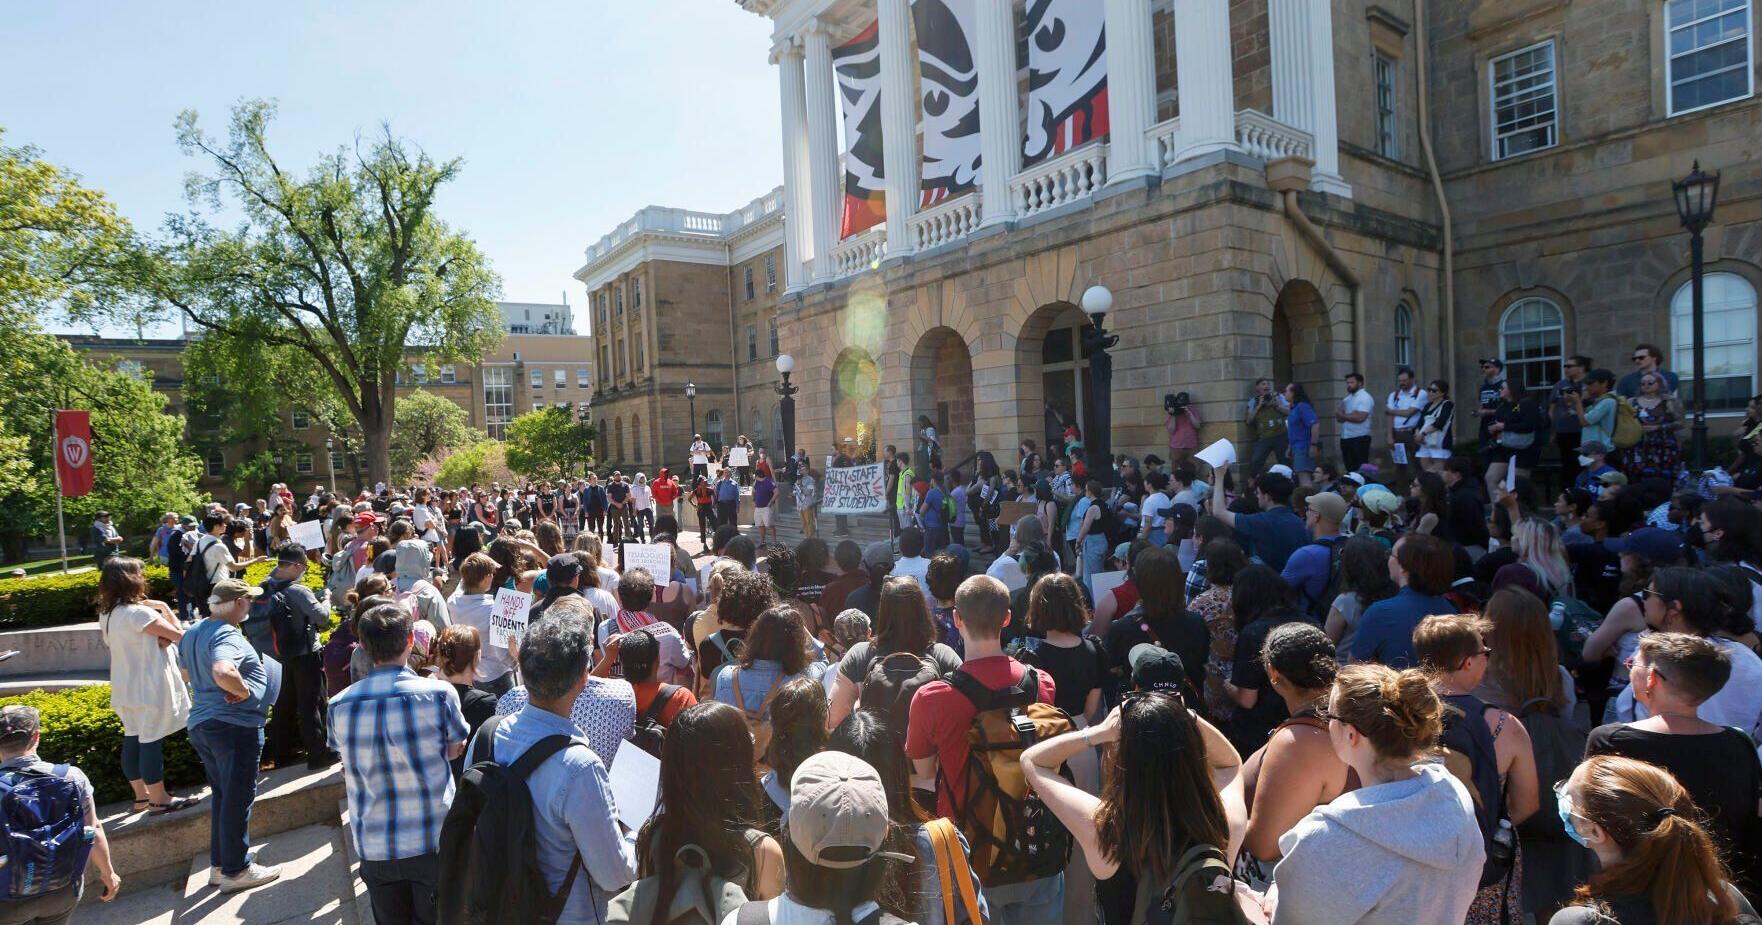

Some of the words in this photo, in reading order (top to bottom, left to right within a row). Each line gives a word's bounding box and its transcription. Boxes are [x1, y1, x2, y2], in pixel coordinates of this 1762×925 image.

[67, 446, 81, 461] W
[851, 466, 878, 482] STAFF
[828, 479, 870, 497] SUPPORT
[838, 495, 880, 509] STUDENTS
[501, 593, 525, 609] HANDS
[491, 614, 525, 631] STUDENTS
[34, 636, 78, 651] HAVE
